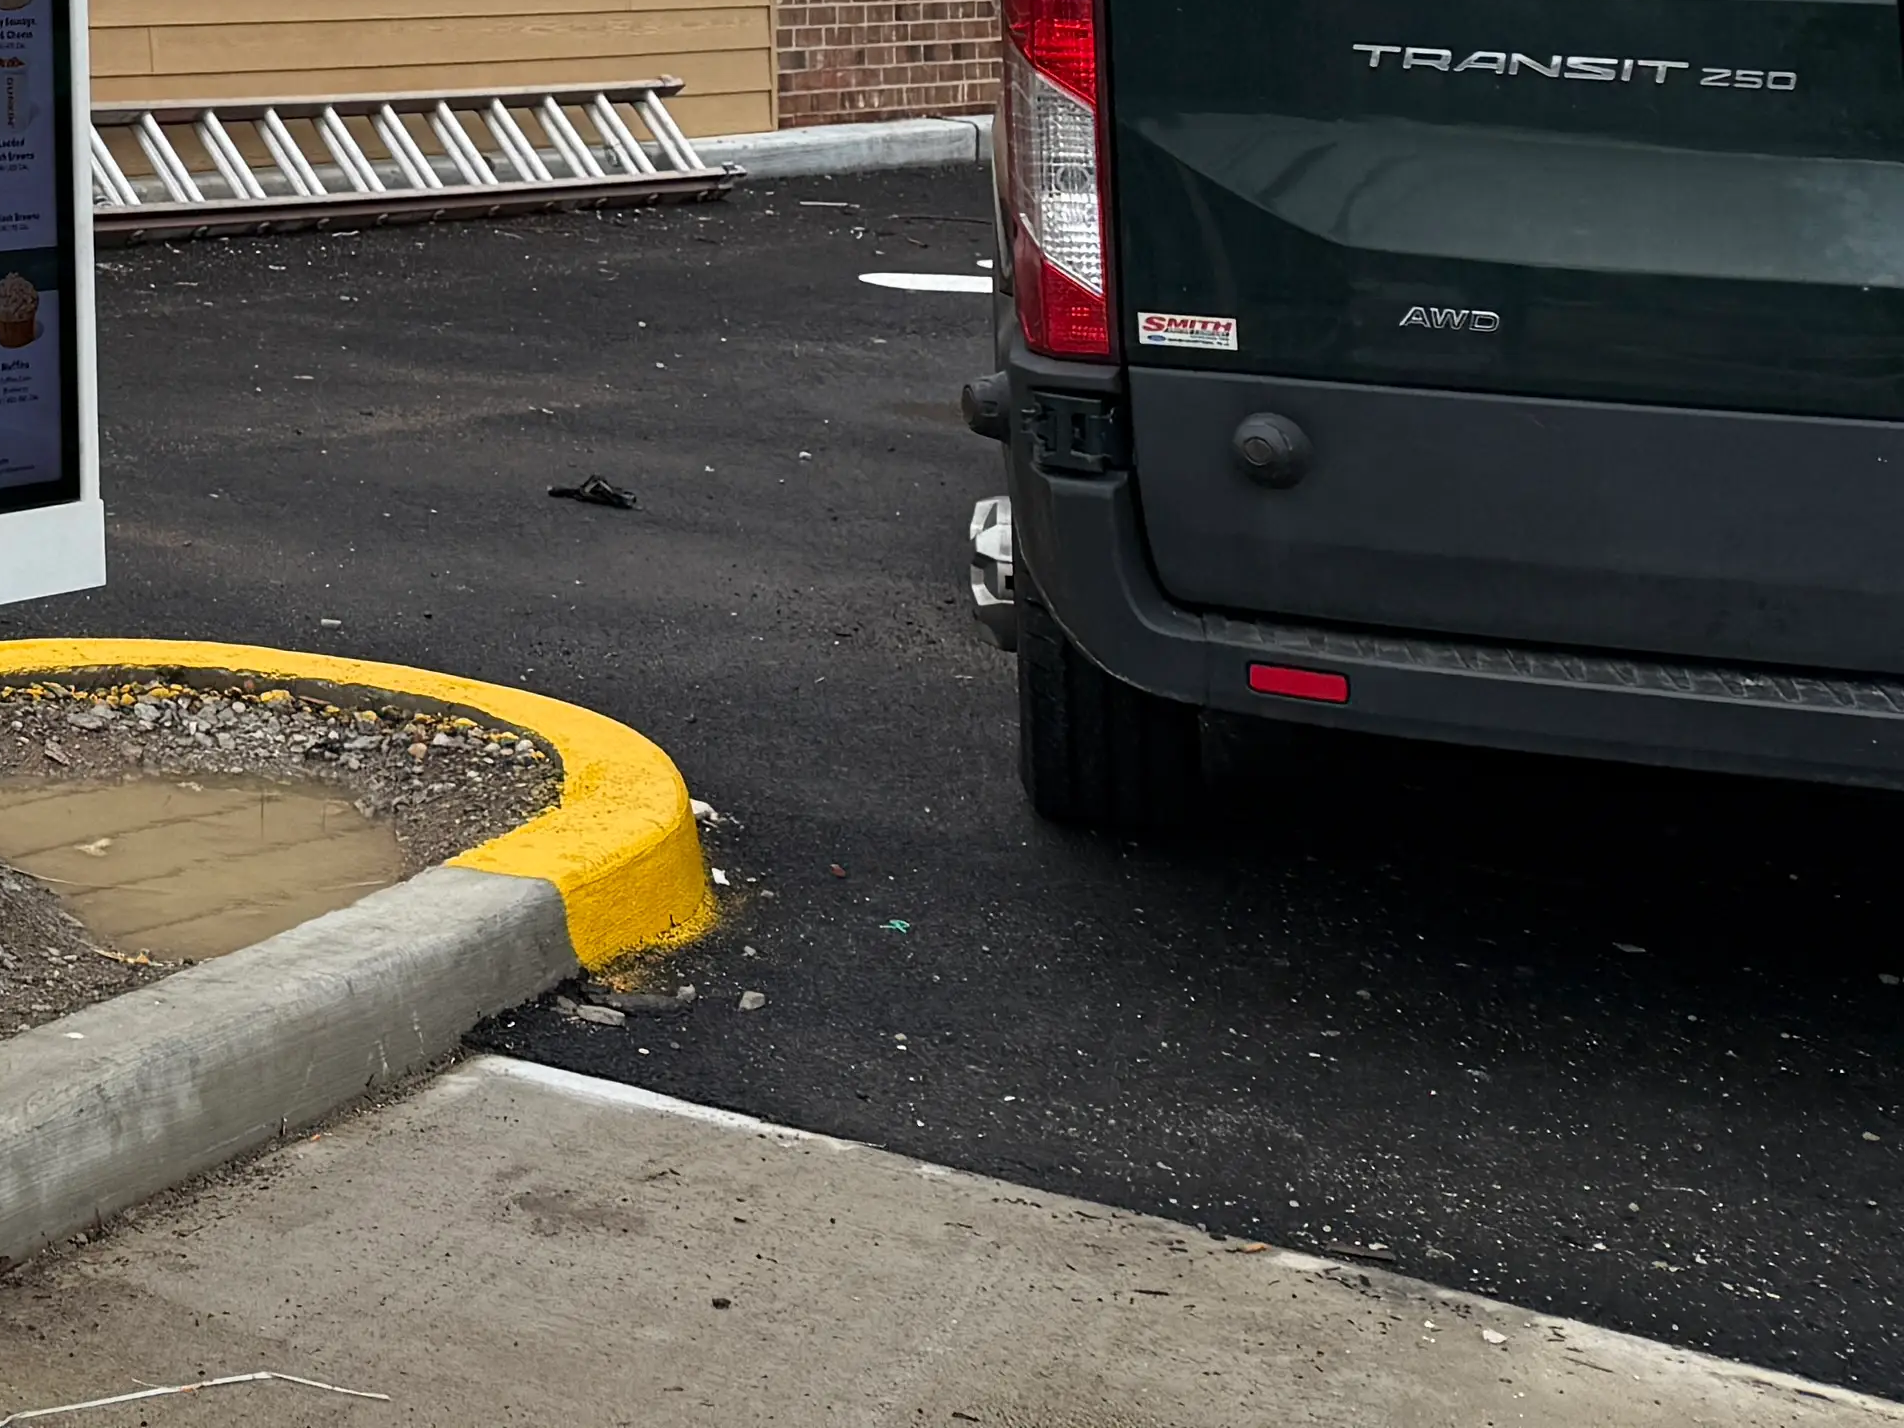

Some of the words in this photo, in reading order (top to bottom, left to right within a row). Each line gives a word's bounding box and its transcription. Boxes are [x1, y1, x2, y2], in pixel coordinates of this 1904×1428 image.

[1353, 44, 1689, 83] TRANSIT
[1700, 68, 1797, 90] 250
[1143, 317, 1232, 332] SMITH
[1399, 306, 1500, 332] AWD
